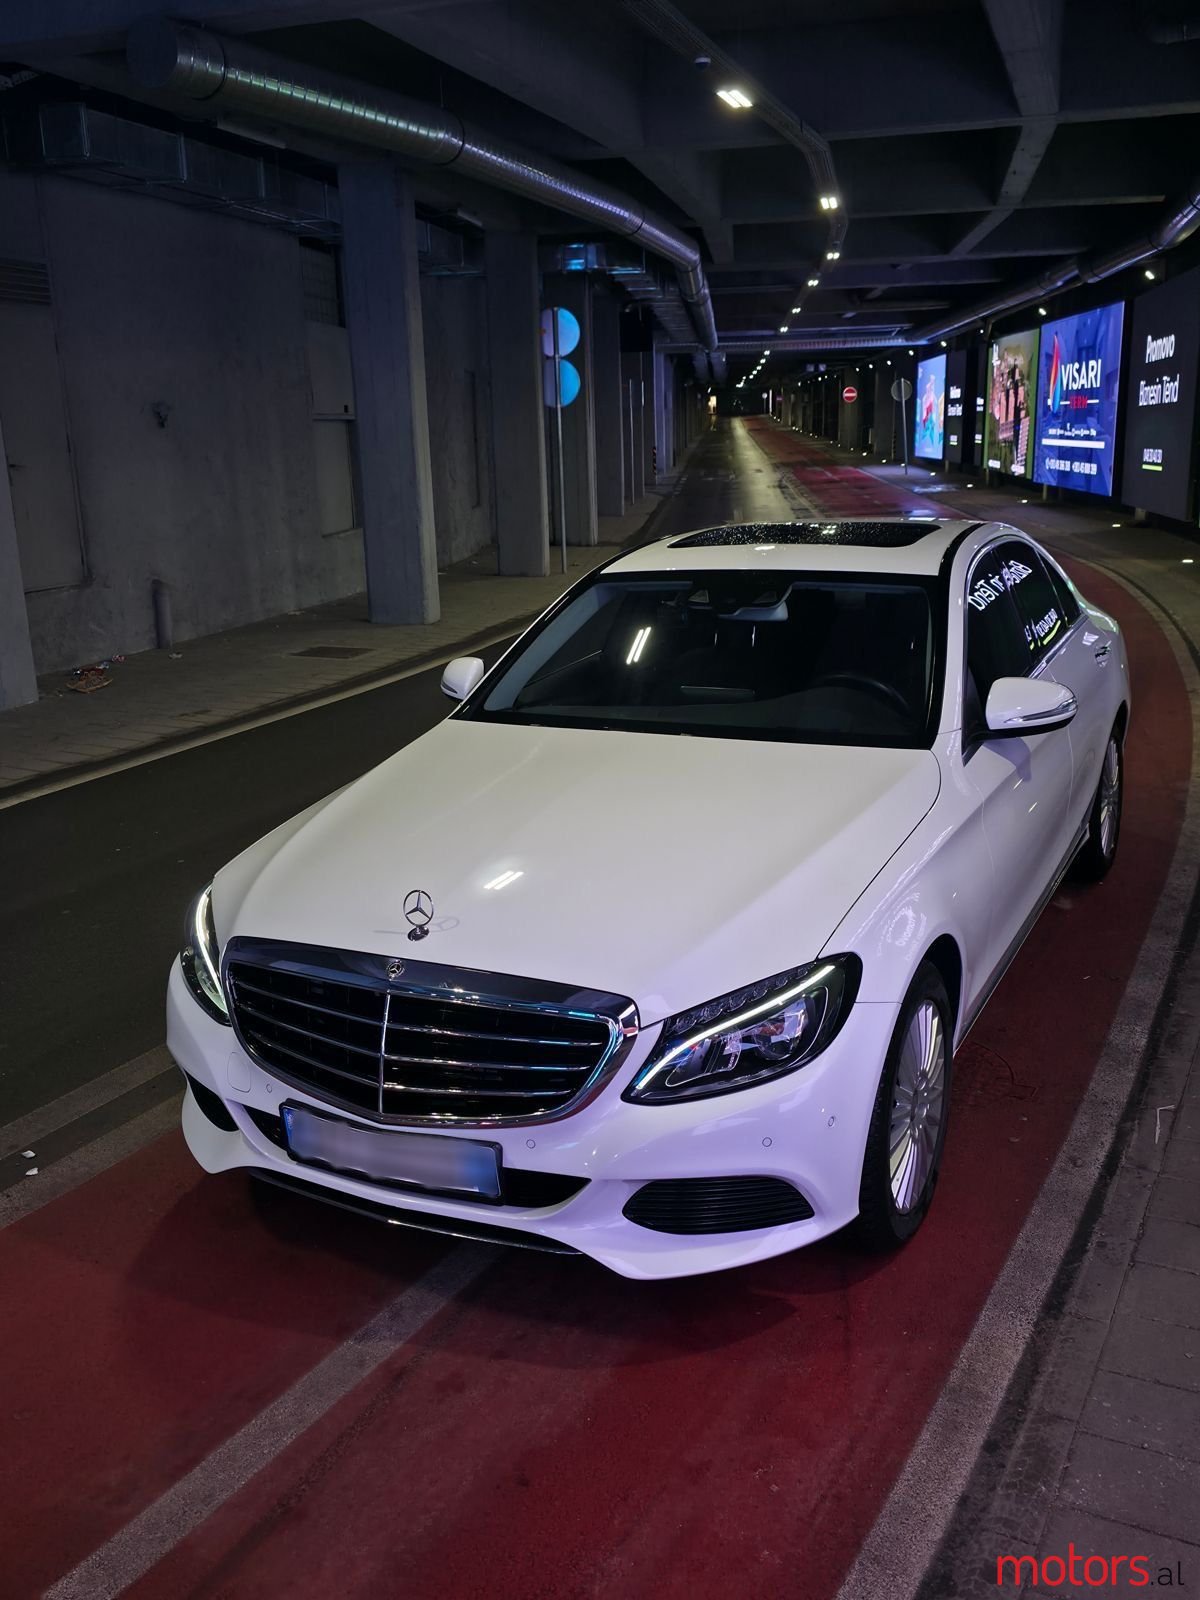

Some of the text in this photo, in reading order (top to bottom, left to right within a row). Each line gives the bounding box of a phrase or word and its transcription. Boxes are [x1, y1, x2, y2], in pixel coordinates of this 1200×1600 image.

[1145, 334, 1175, 363] Promovo
[1061, 359, 1102, 391] VISARI
[1139, 373, 1180, 406] Biznesin Tënd
